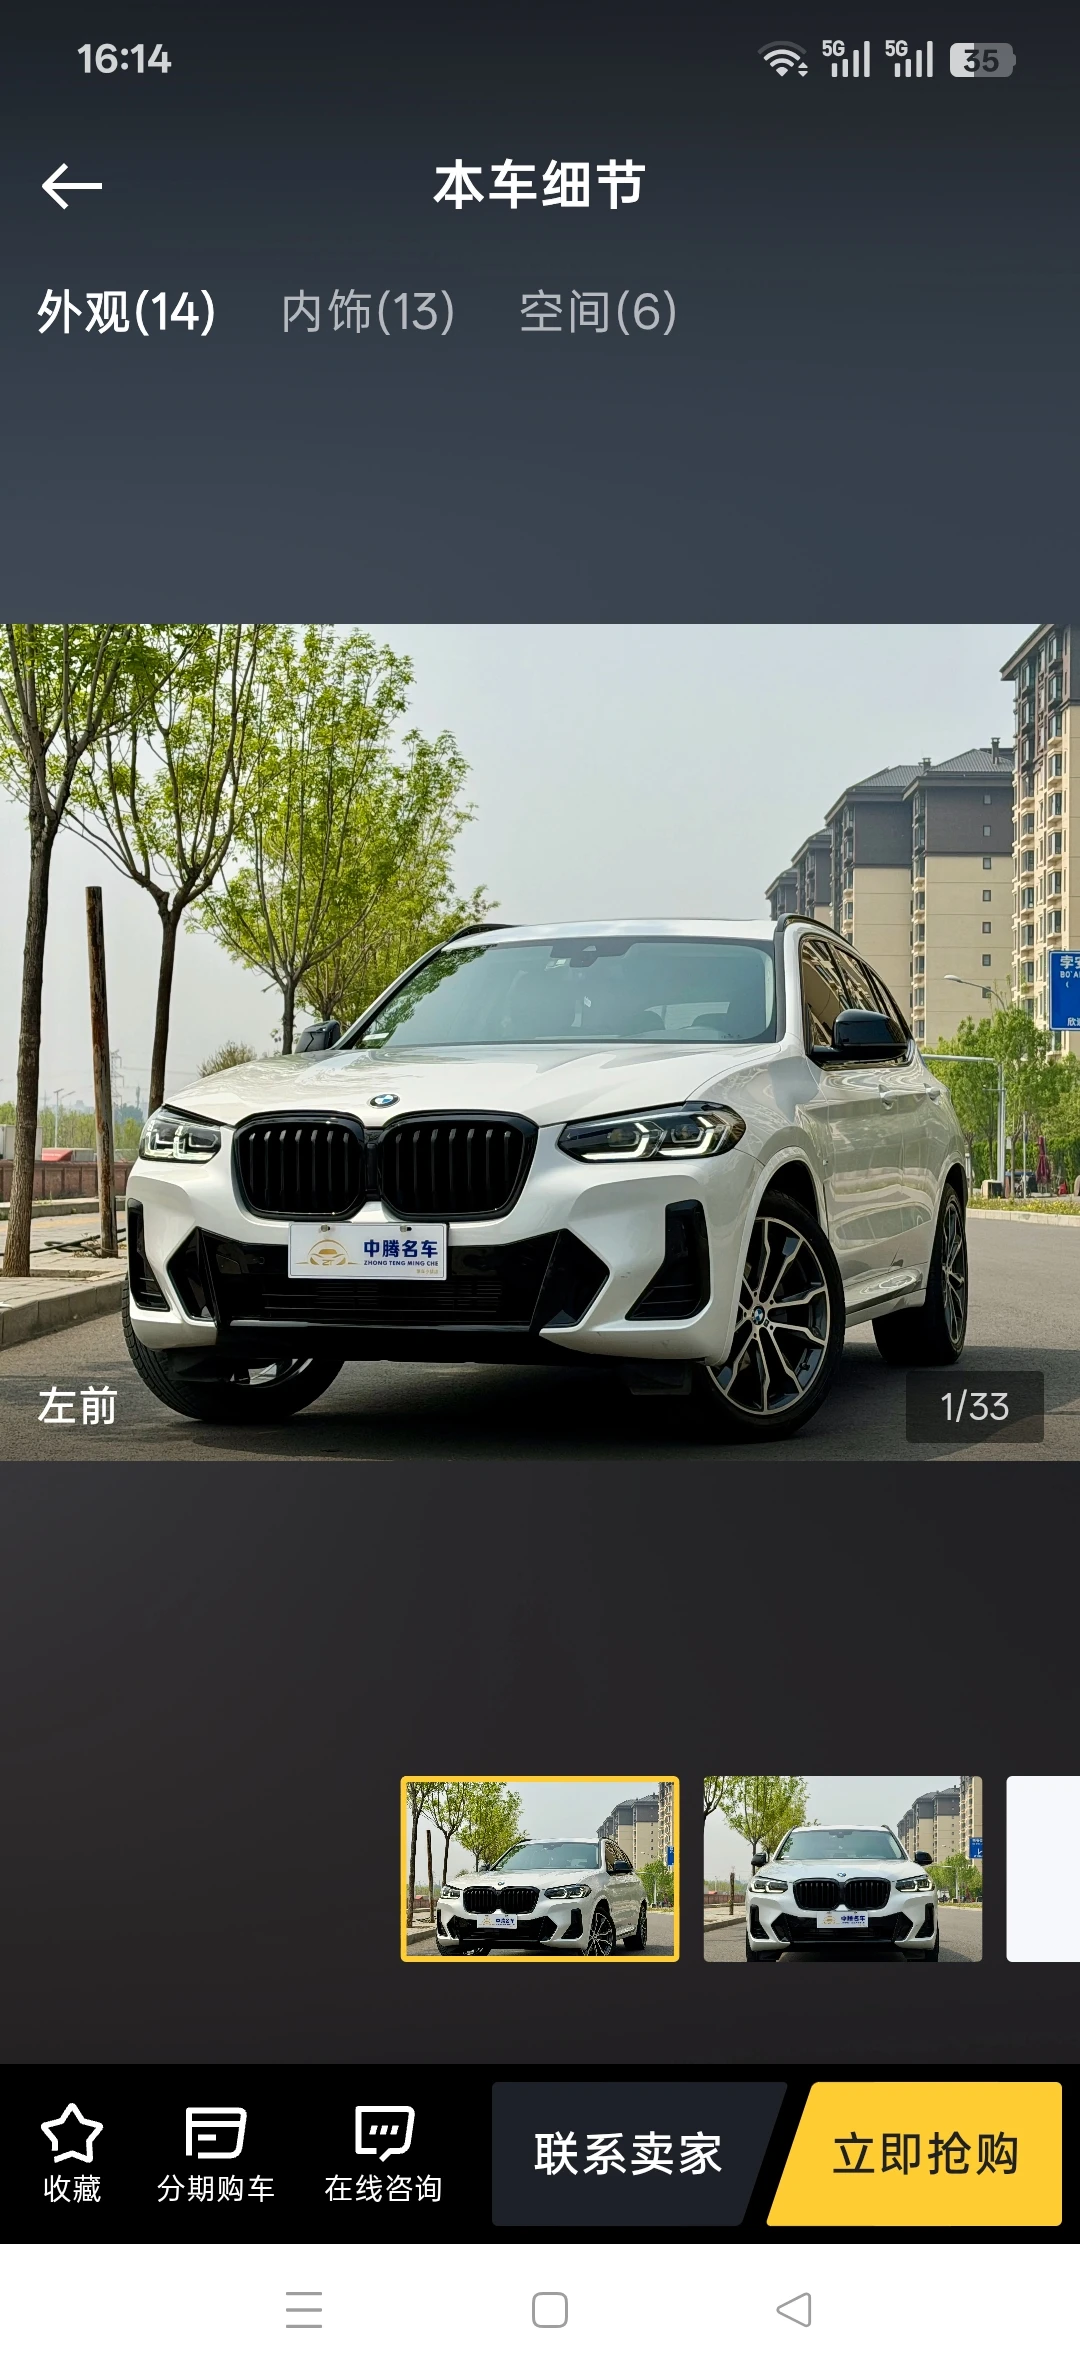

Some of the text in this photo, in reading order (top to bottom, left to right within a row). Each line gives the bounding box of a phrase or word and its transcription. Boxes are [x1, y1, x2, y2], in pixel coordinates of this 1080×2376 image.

[77, 42, 173, 74] 16:14
[821, 39, 846, 57] 5G
[884, 39, 909, 57] 5G
[963, 49, 1000, 73] 35
[432, 157, 647, 210] 本车细节
[36, 288, 216, 337] 外观(14)
[282, 288, 455, 336] 内饰(13)
[519, 288, 677, 336] 空间(6)
[363, 1239, 439, 1258] 中腾名车
[533, 2130, 723, 2177] 联系卖家
[832, 2130, 1019, 2177] 立即抢购
[42, 2173, 102, 2204] 收藏
[156, 2173, 276, 2204] 分期购车
[324, 2173, 443, 2204] 在线咨询
